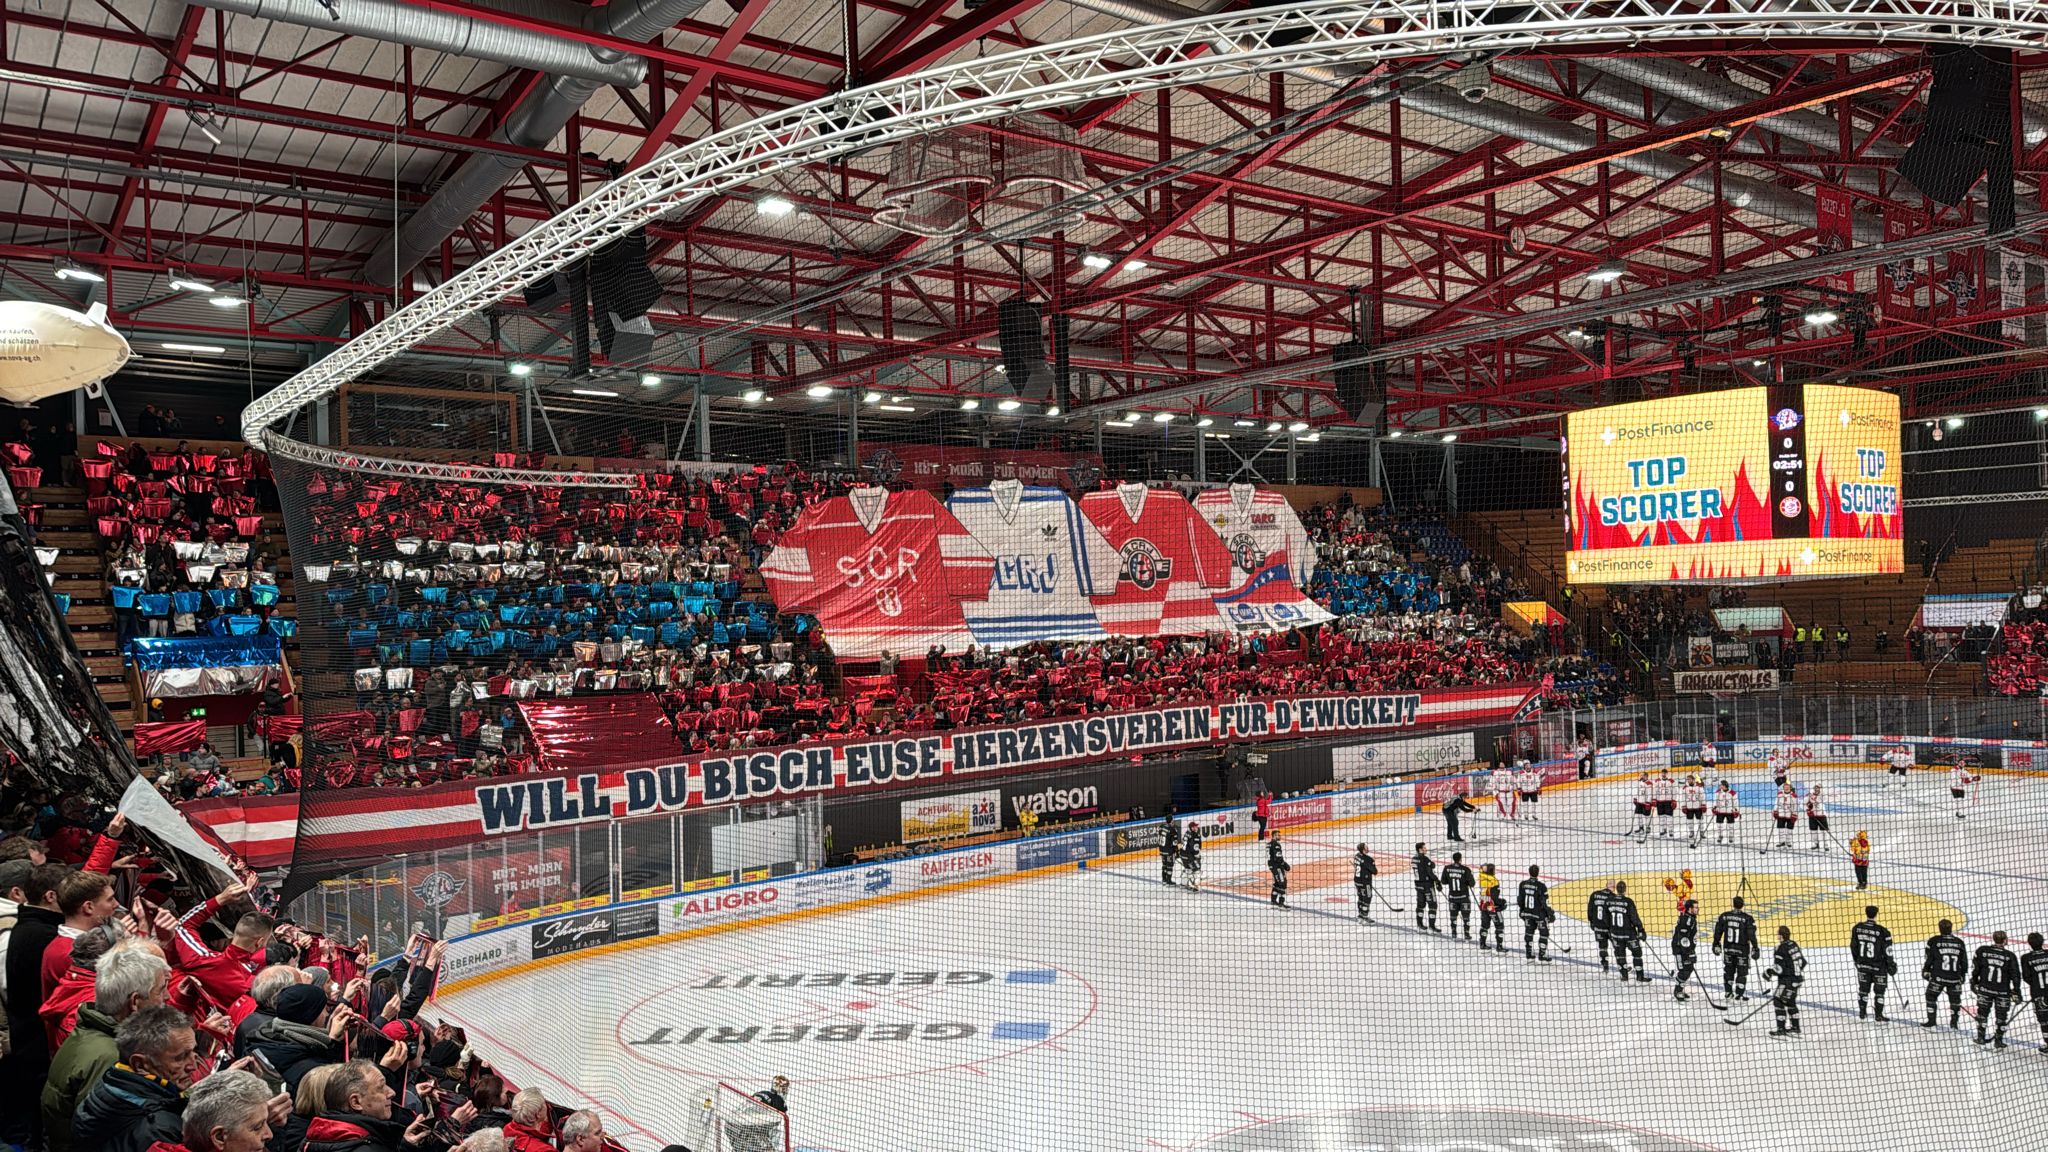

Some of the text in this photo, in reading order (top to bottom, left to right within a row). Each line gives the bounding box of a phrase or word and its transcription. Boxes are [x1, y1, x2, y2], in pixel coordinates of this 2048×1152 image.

[8, 336, 39, 345] schätzen
[1617, 418, 1715, 441] PostFinance
[1850, 411, 1894, 430] PostFinance
[1783, 437, 1794, 449] 0
[1627, 455, 1687, 489] TOP
[1773, 460, 1803, 470] 02:51
[1856, 447, 1886, 479] TOP
[1785, 480, 1795, 492] 0
[1600, 488, 1722, 526] SCORER
[1840, 482, 1897, 516] SCORER
[836, 545, 921, 589] SCR
[1577, 558, 1654, 574] PostFinance
[1818, 550, 1873, 564] PostFinance
[990, 553, 1059, 593] CRJ
[477, 775, 610, 832] WILL
[625, 766, 688, 814] DU
[703, 747, 834, 802] BISCH
[846, 736, 941, 783] EUSE
[952, 706, 1210, 772] HERZENSVEREIN
[1220, 694, 1268, 735] FÜR
[1012, 785, 1098, 817] watson
[972, 813, 996, 827] nova
[1128, 826, 1147, 838] SWISS
[921, 852, 993, 877] RAIFFEISEN
[682, 887, 779, 917] ALIGRO
[1611, 912, 1624, 928] 10
[534, 915, 612, 949] Schnyder
[450, 947, 502, 970] EBERHARD
[547, 938, 602, 956] MODEHAUS
[690, 970, 993, 990] GEBERIT
[629, 1022, 978, 1045] GEBERIT
